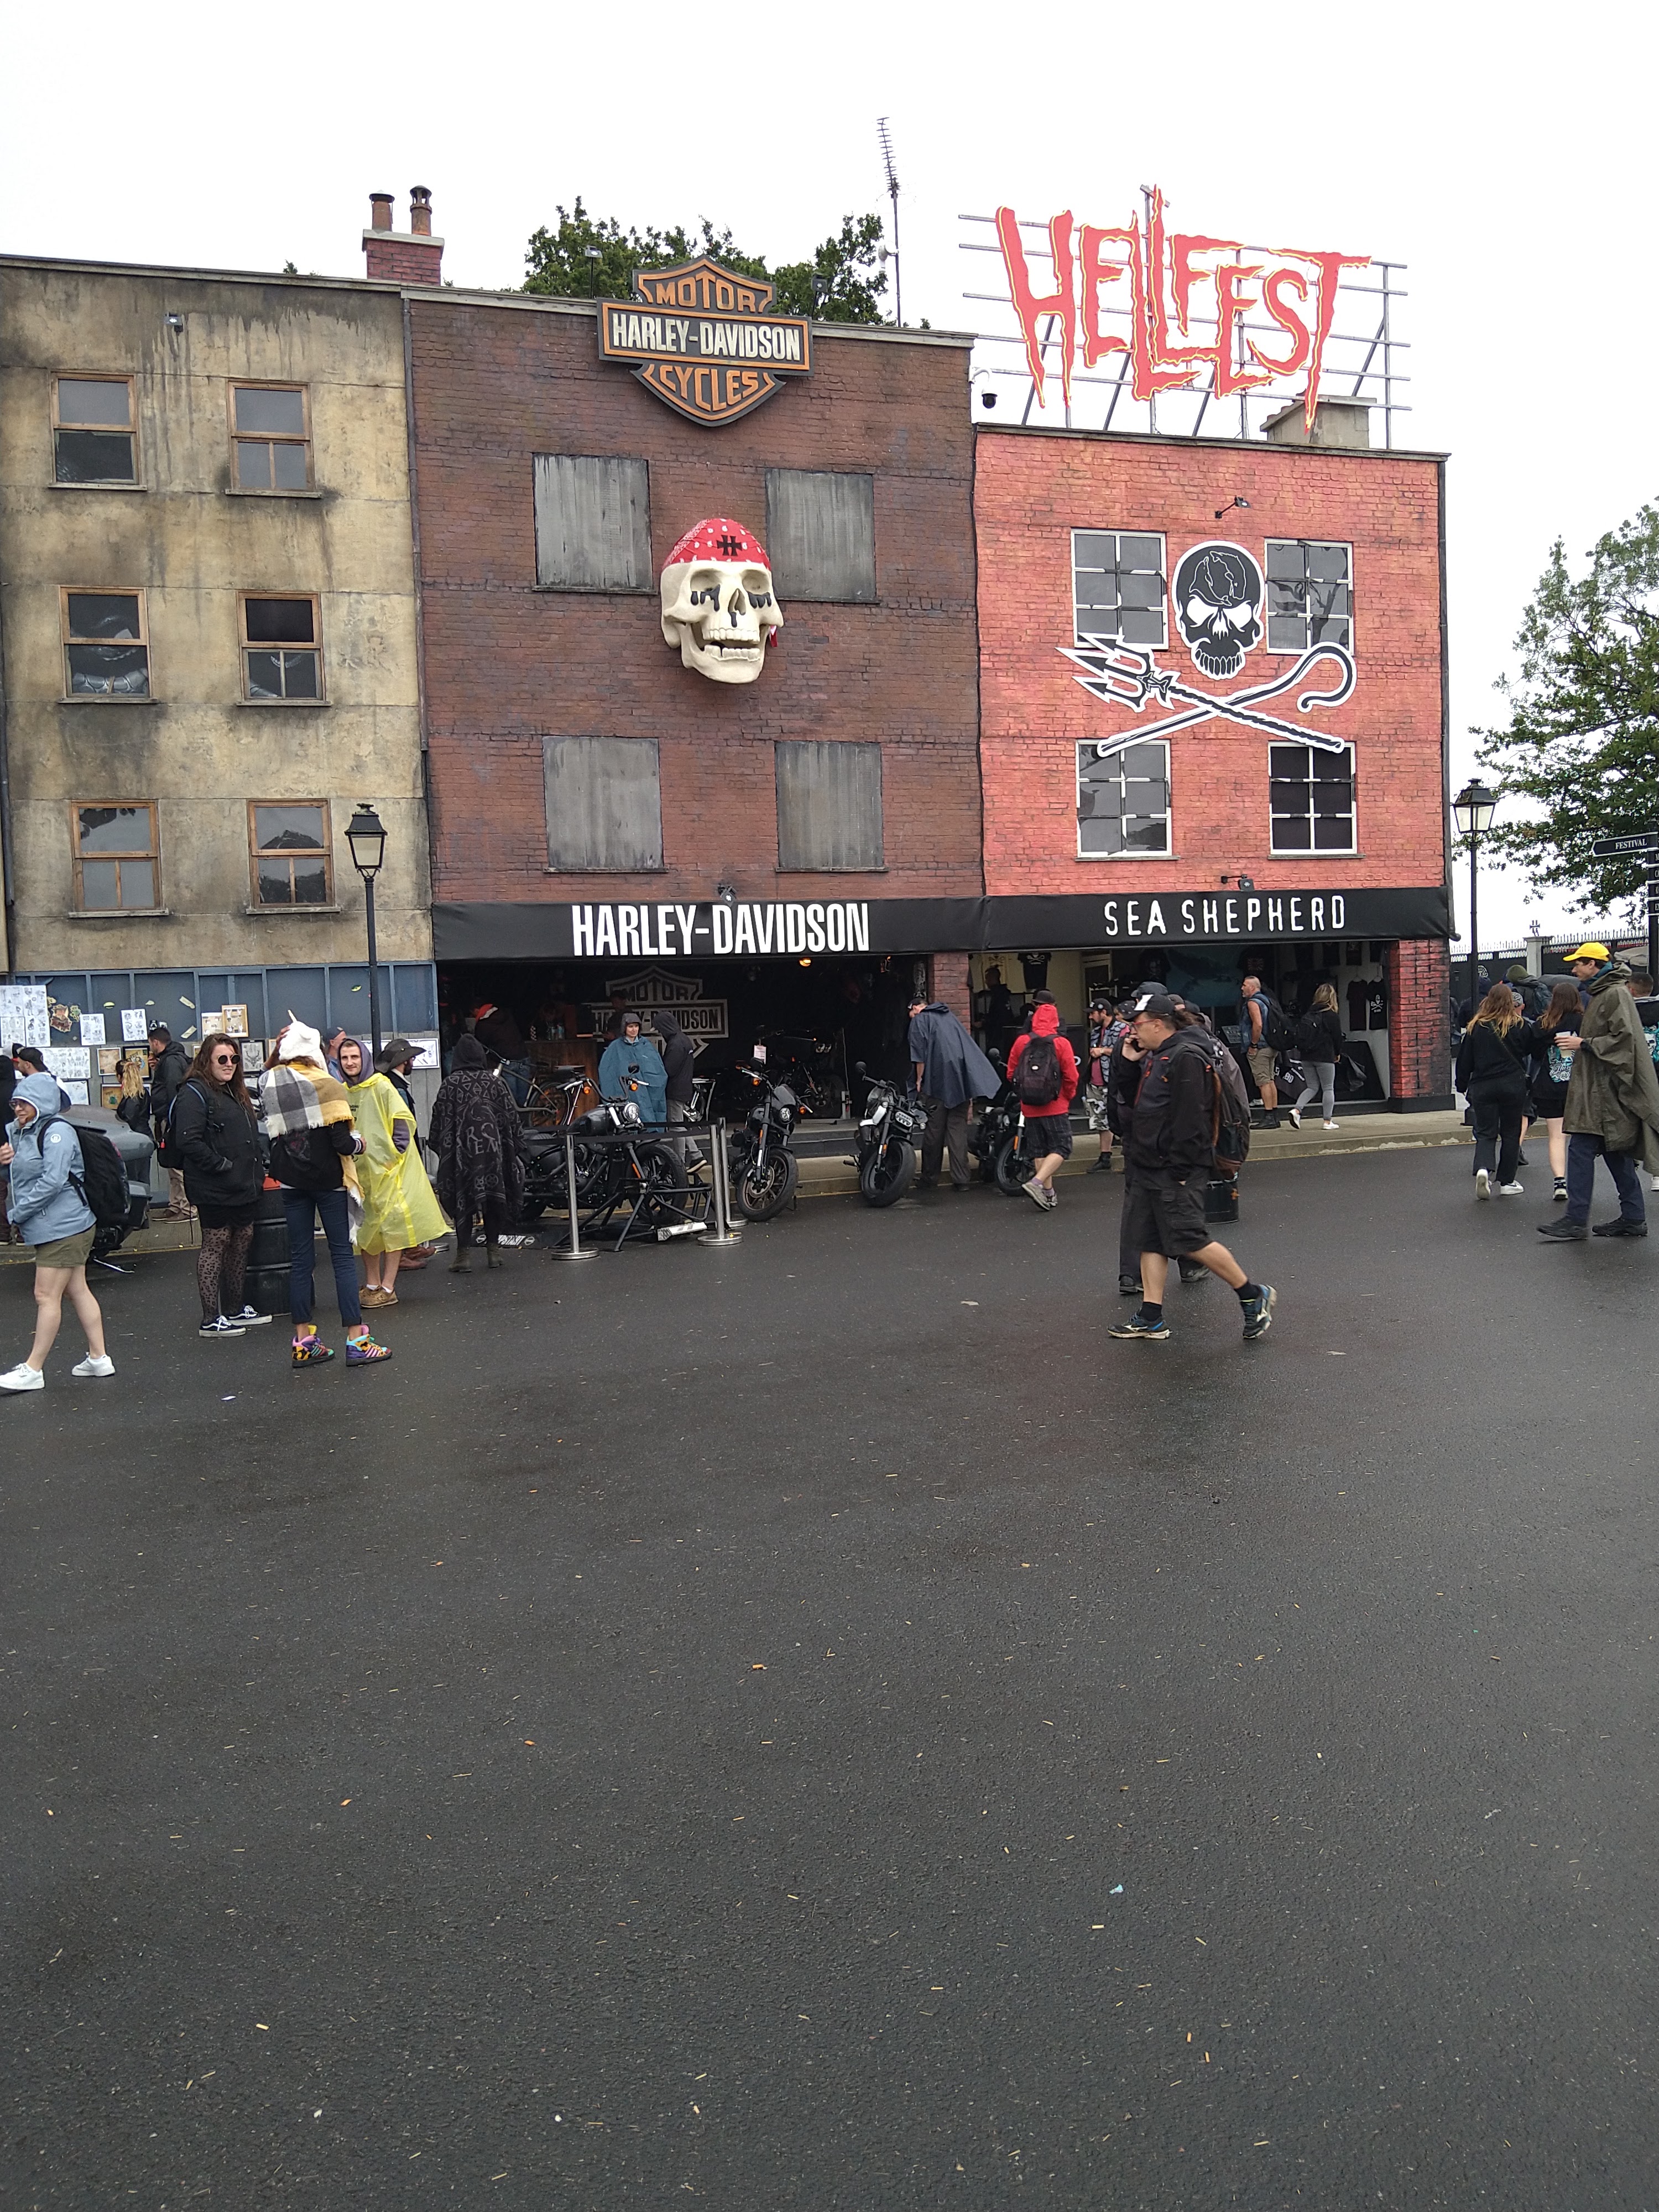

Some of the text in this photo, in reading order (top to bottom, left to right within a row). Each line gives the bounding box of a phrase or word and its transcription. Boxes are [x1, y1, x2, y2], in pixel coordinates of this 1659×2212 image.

[656, 270, 756, 312] MOTOR
[995, 184, 1373, 435] HELLFEST
[612, 313, 801, 361] HARLEY-DAVIDSON
[659, 364, 759, 412] CYCLES
[1615, 838, 1647, 850] FESTIVAL
[571, 902, 870, 957] HARLEY-DAVIDSON
[1104, 895, 1345, 936] SEA SHEPHERD
